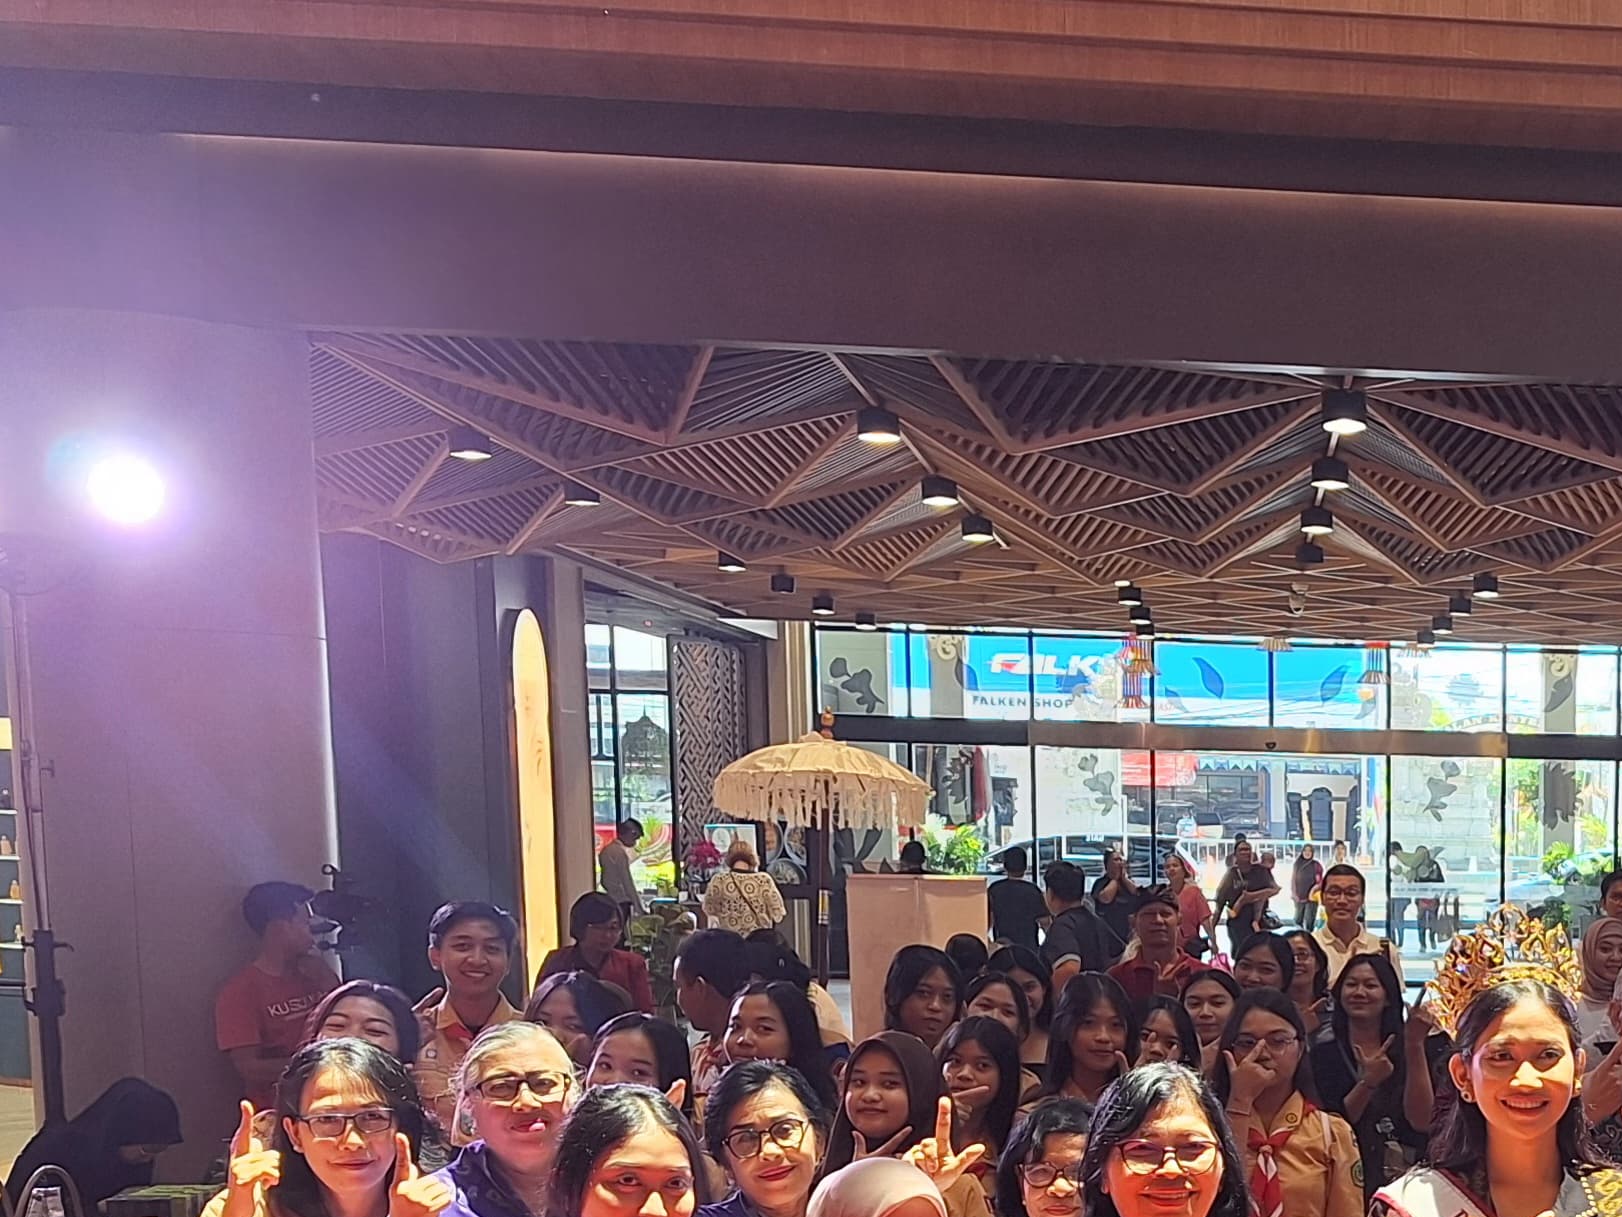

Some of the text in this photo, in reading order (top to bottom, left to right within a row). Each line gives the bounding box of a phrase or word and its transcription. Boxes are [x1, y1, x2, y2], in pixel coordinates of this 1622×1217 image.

[986, 652, 1116, 677] FALK
[973, 695, 1073, 709] FALKEN SHOP
